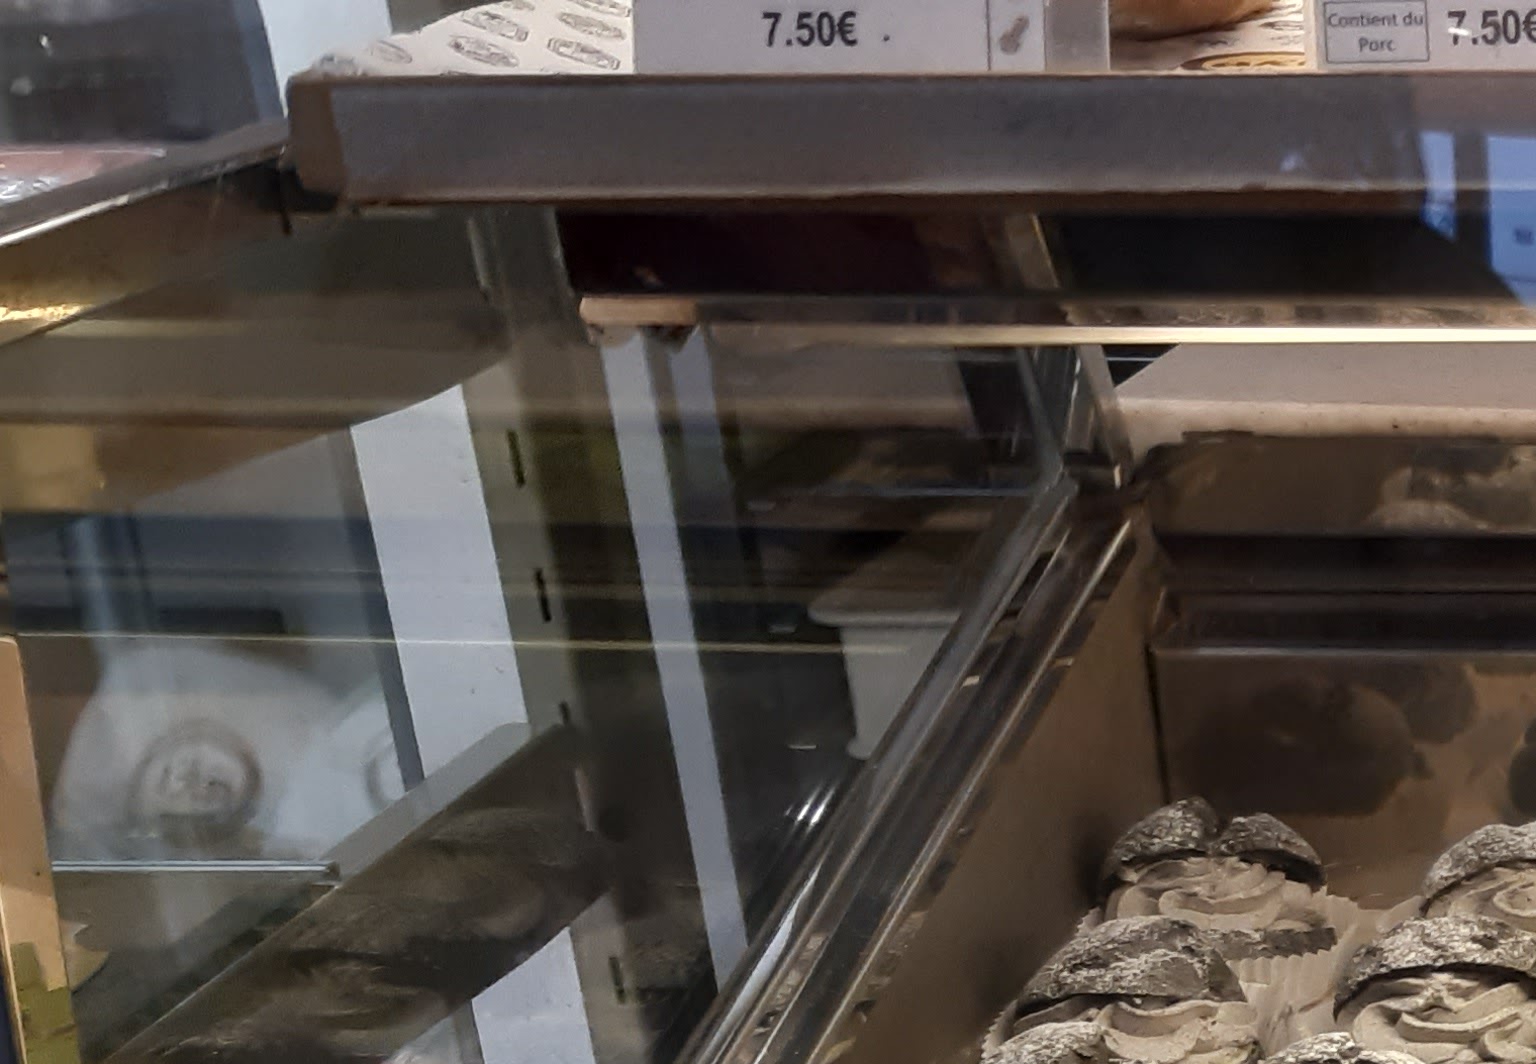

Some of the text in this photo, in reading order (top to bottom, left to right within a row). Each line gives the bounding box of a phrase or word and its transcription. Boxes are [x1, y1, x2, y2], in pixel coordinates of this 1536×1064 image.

[1327, 11, 1424, 28] Contient du
[761, 10, 859, 47] 7.50€
[1357, 36, 1398, 52] Porc
